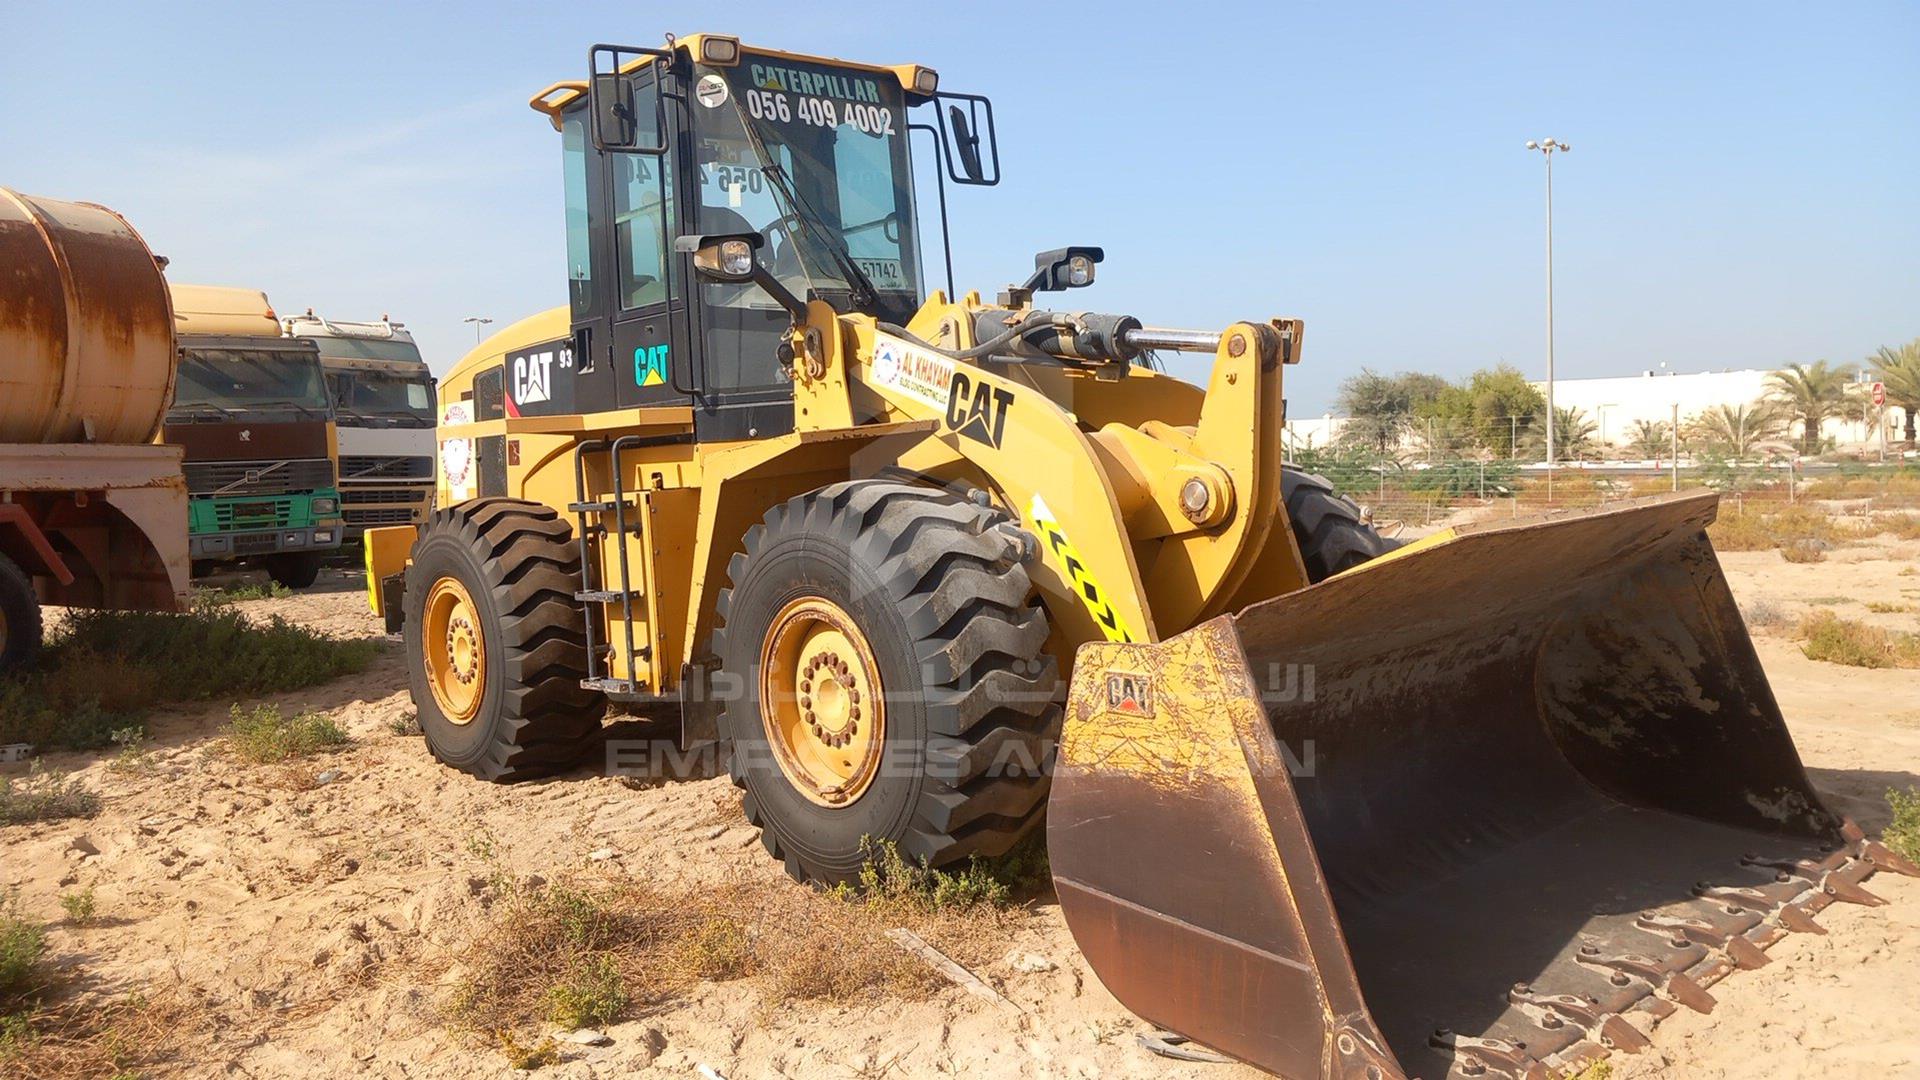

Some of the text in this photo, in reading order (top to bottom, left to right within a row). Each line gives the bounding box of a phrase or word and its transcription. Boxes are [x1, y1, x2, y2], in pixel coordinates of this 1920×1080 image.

[751, 63, 880, 103] CATERPILLAR
[746, 89, 791, 123] 056
[798, 97, 838, 129] 409
[844, 103, 896, 136] 4002
[514, 352, 553, 405] CAT
[635, 344, 668, 386] CAT
[946, 372, 1015, 450] CAT
[1107, 677, 1148, 712] CAT
